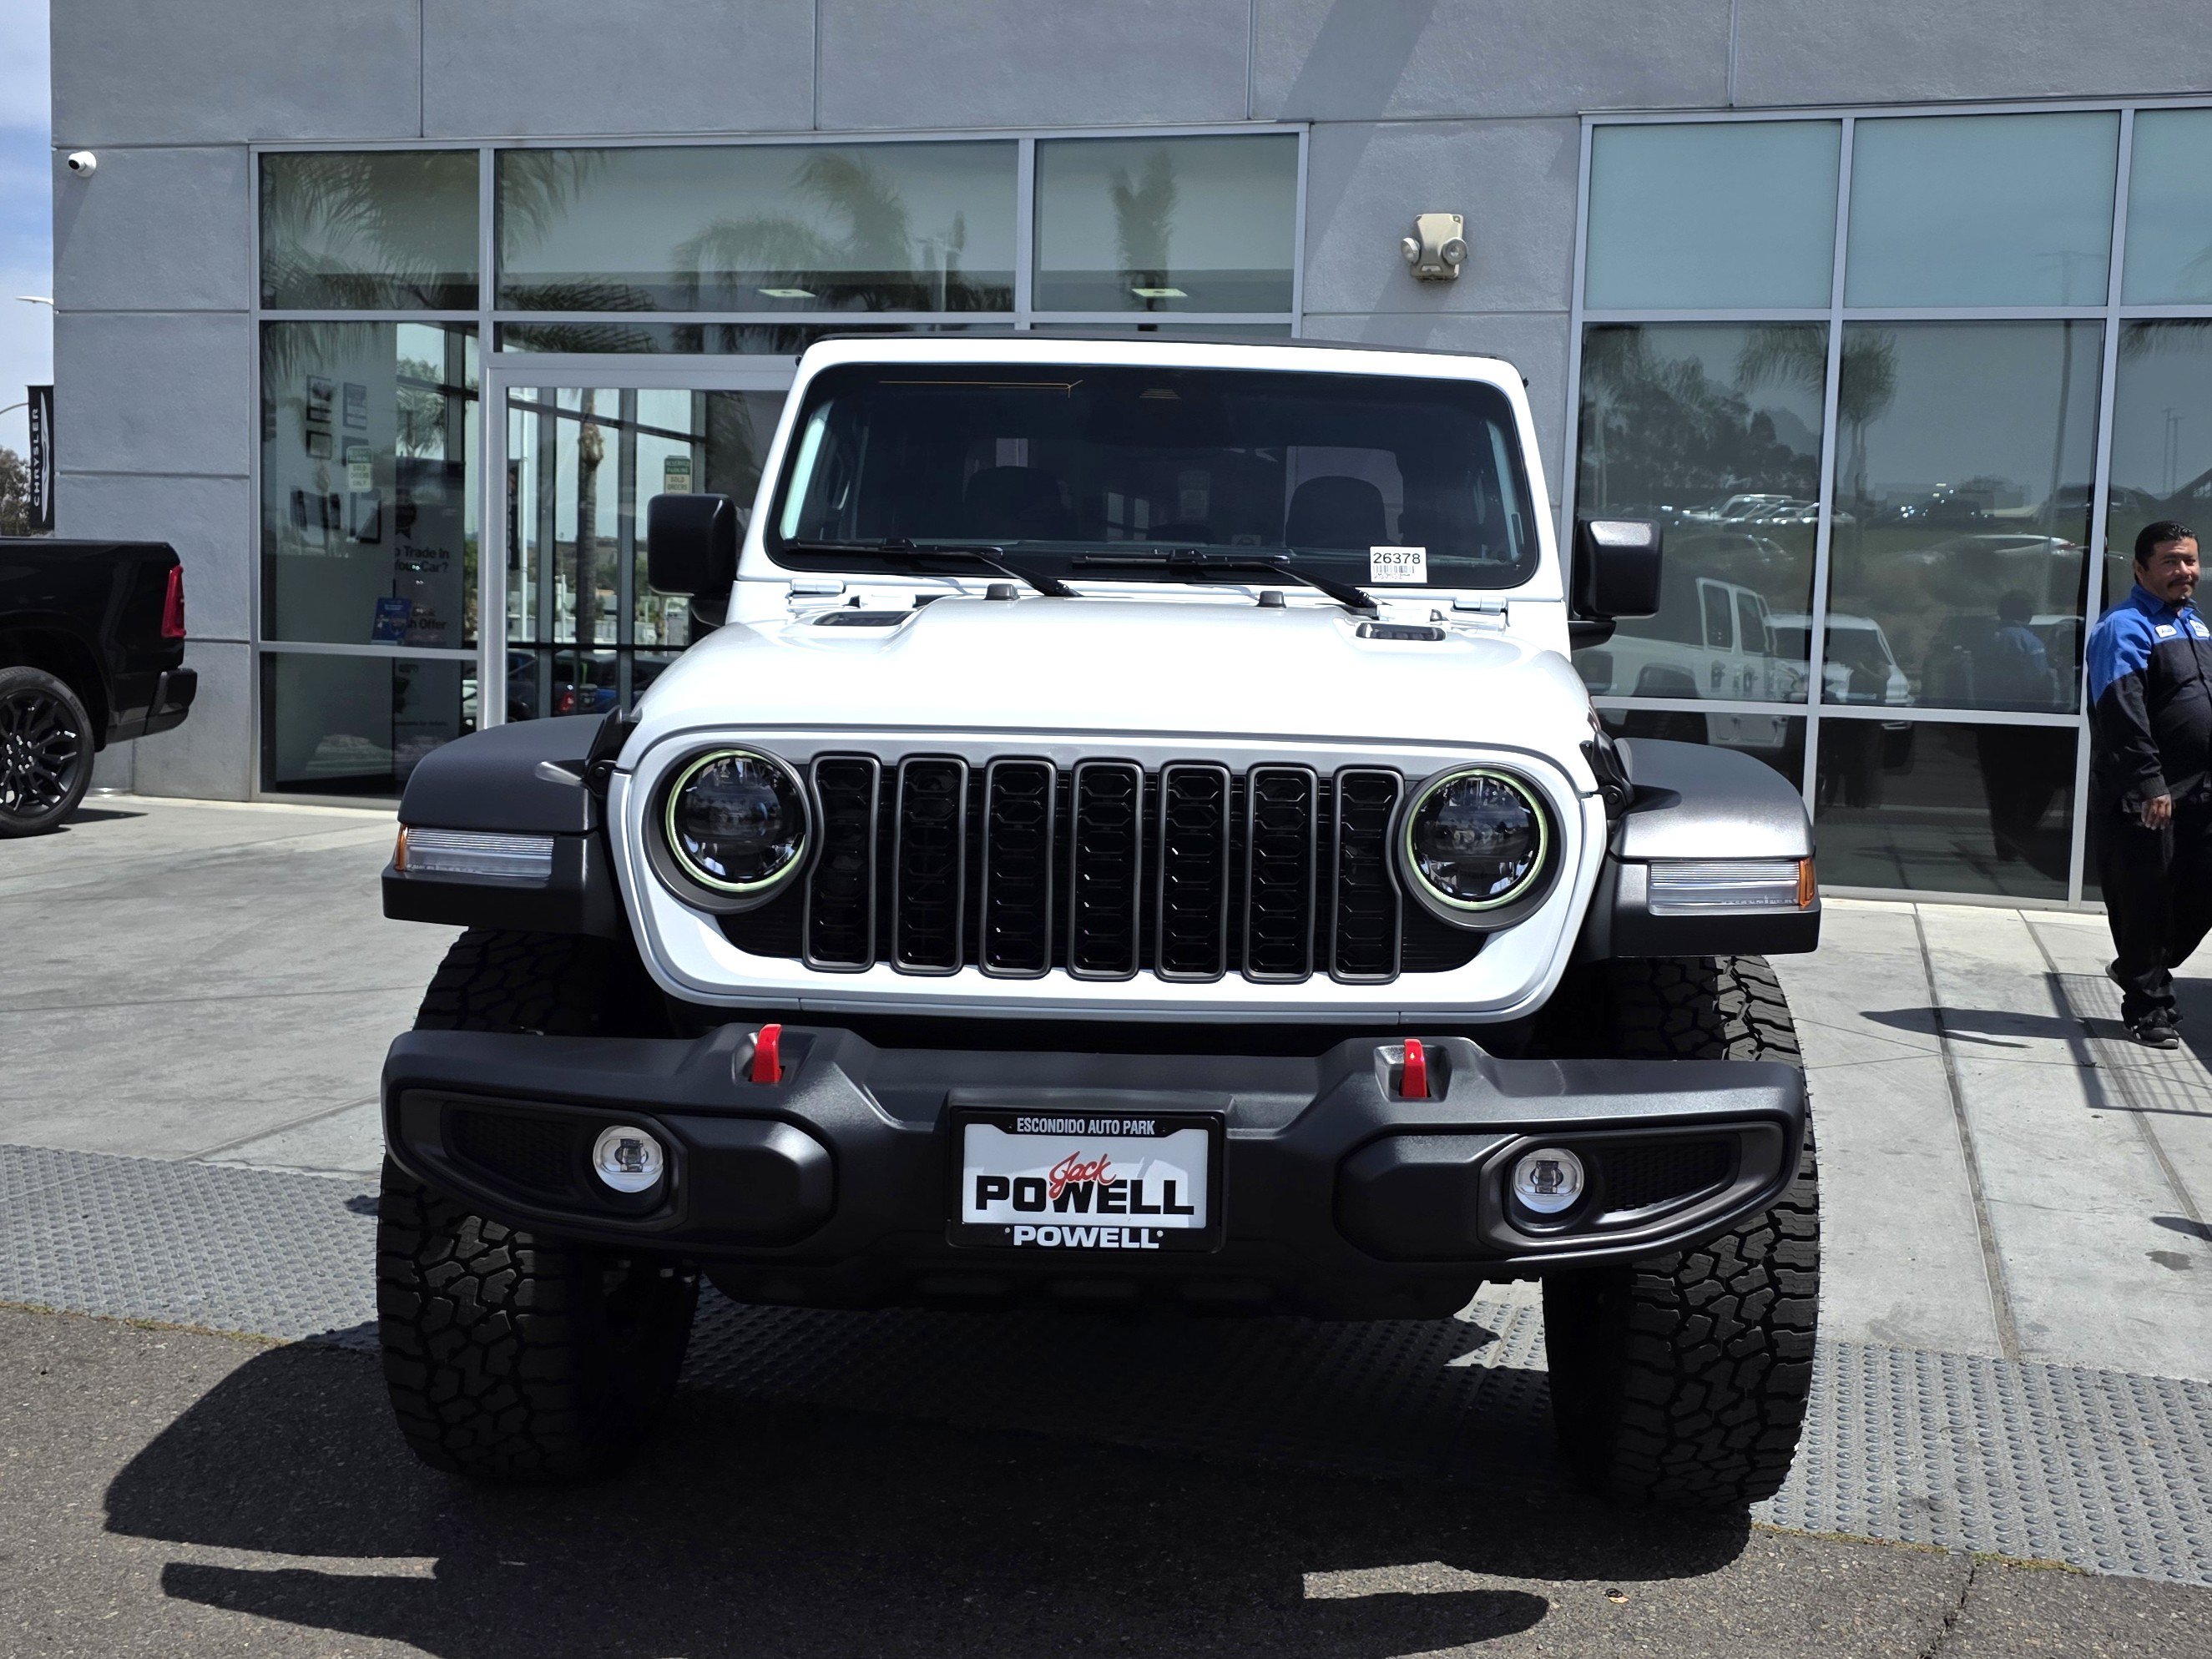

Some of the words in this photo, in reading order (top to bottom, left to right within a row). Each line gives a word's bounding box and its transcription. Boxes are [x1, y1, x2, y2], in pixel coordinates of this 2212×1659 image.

[32, 407, 40, 507] CHRYSLER
[403, 545, 437, 558] Trade
[1372, 552, 1421, 564] 26378
[421, 560, 448, 573] Car?
[419, 618, 447, 630] Offer
[1017, 1117, 1085, 1134] ESCONDIDO
[1088, 1119, 1119, 1134] AUTO
[1123, 1120, 1155, 1135] PARK
[1048, 1150, 1117, 1201] Jack
[975, 1174, 1194, 1215] POWELL
[1013, 1225, 1159, 1248] POWELL
